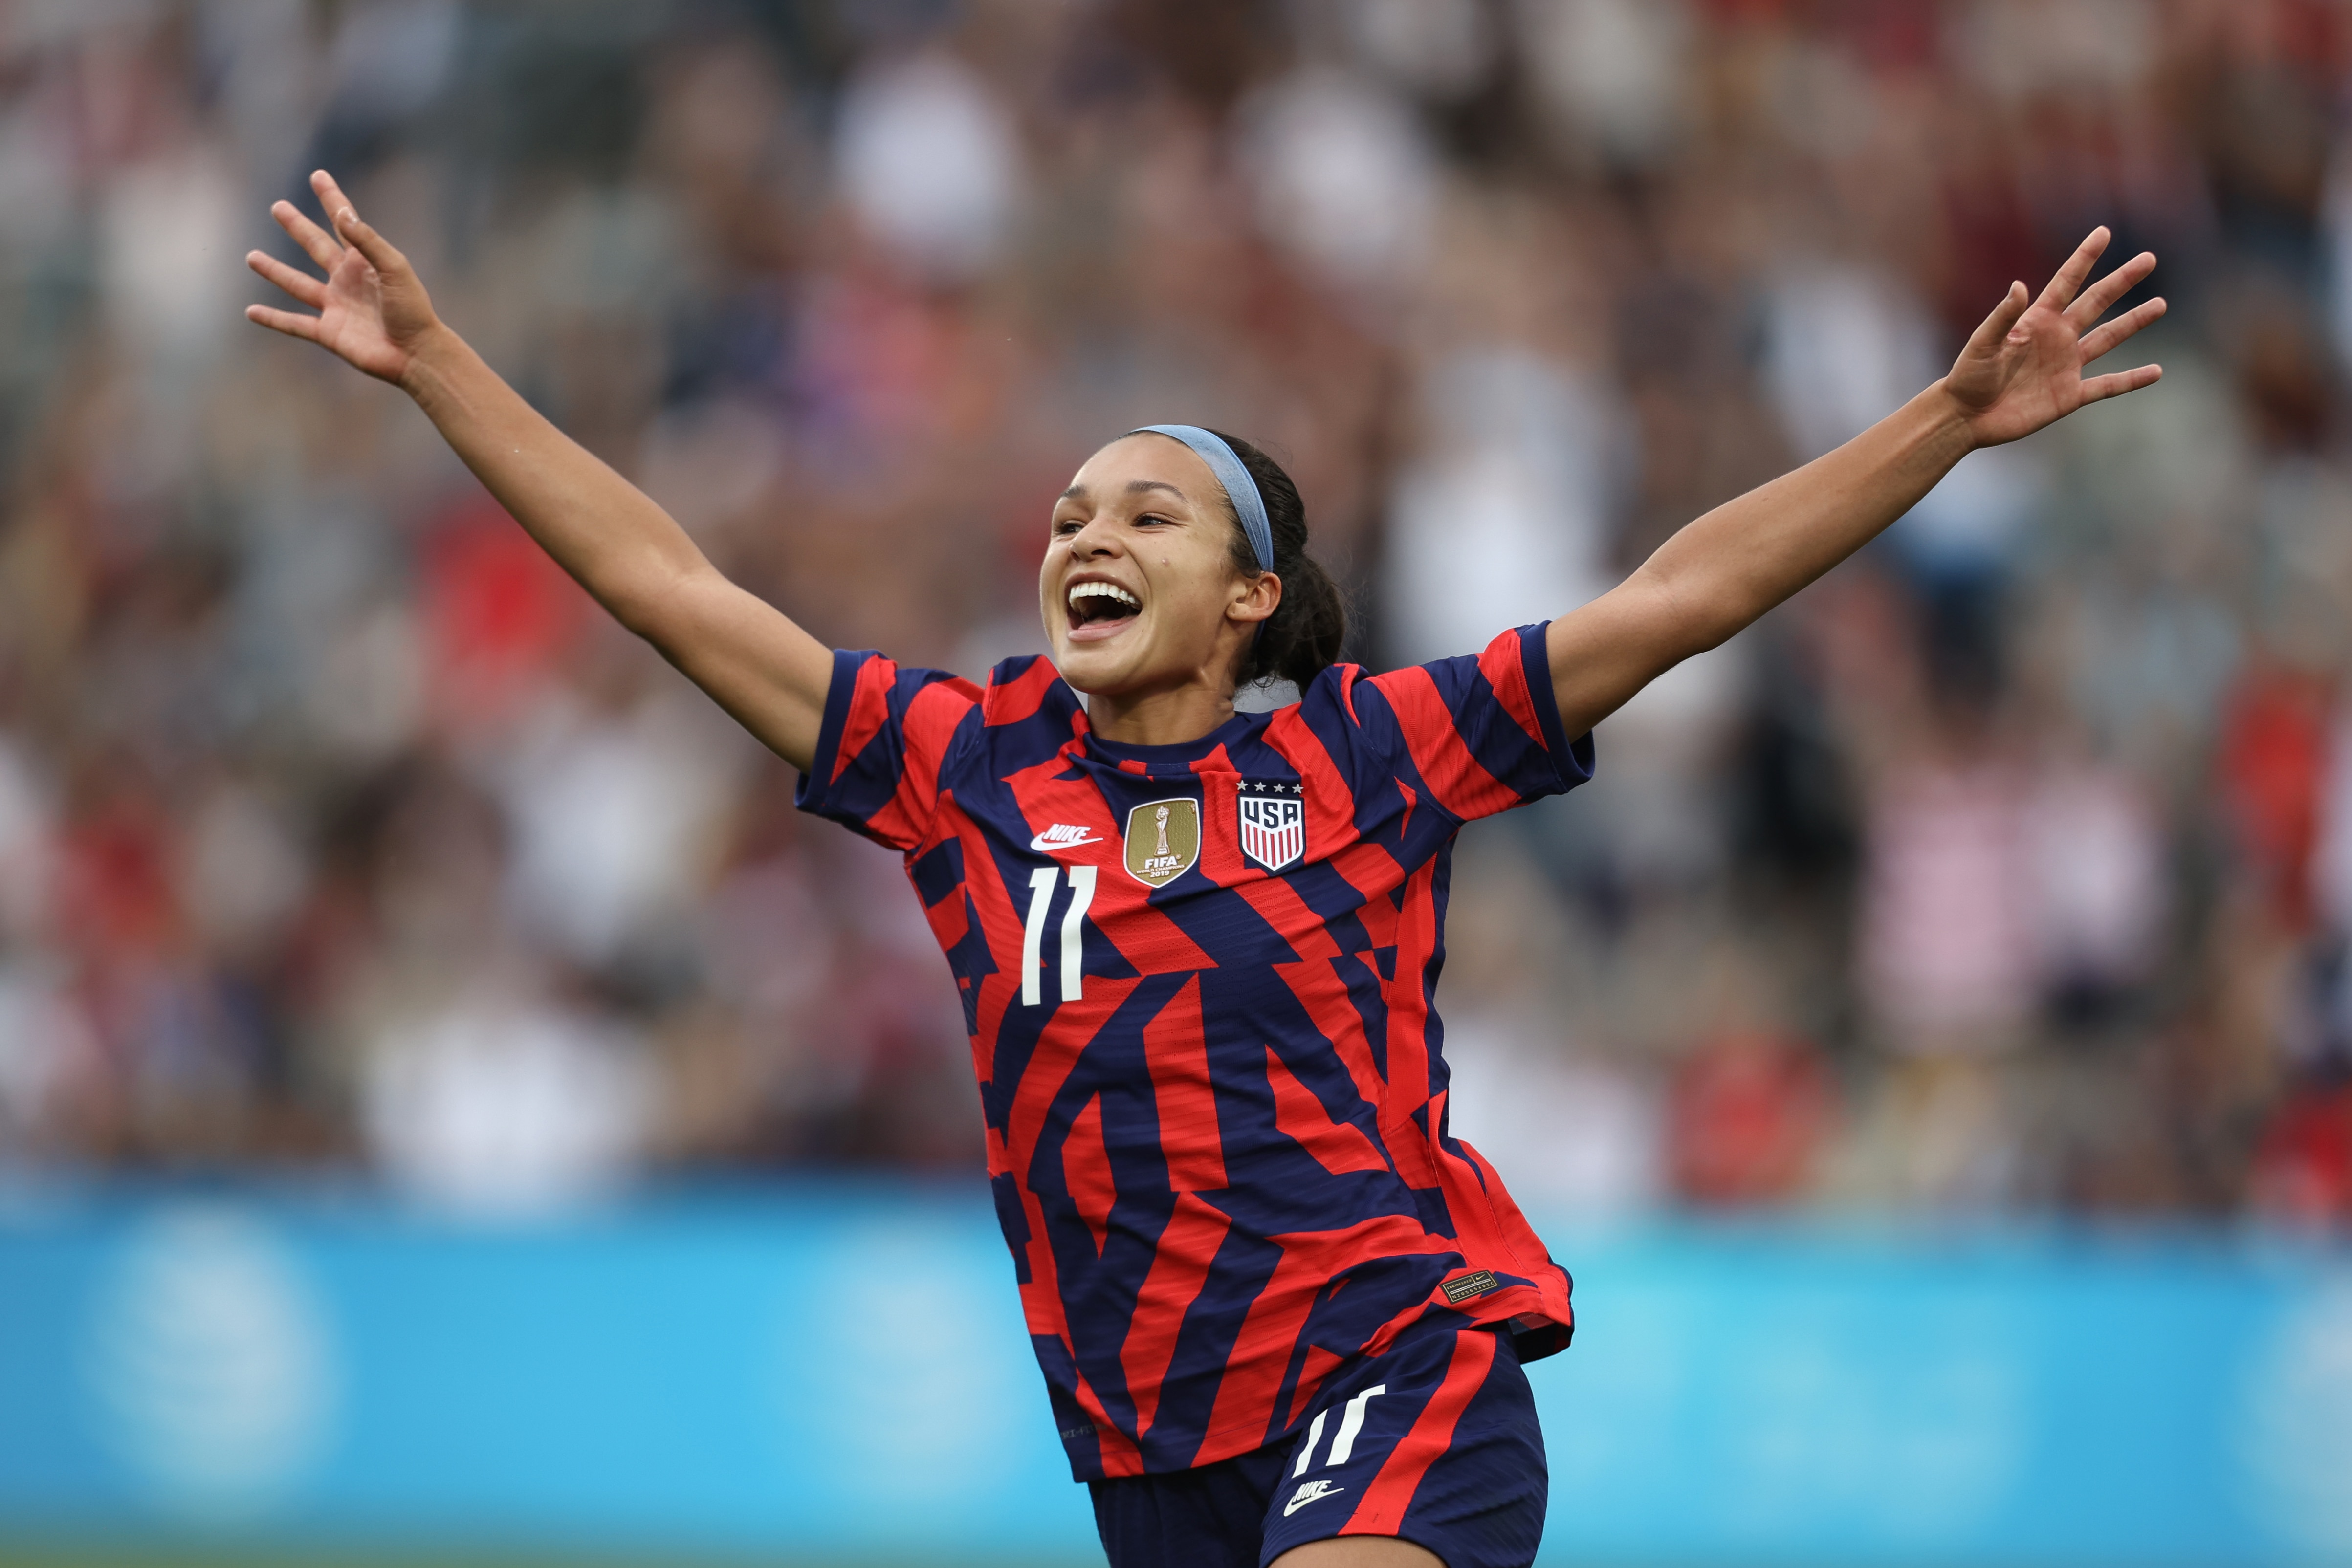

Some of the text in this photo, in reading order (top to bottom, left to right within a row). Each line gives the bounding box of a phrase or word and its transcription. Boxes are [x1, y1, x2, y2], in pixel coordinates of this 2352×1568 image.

[1244, 801, 1298, 829] USA
[1043, 823, 1091, 842] NIKE
[1145, 856, 1178, 869] FIFA
[1022, 866, 1098, 1006] 11
[1447, 1279, 1472, 1290] ENGINEERED
[1292, 1384, 1385, 1479] 11
[1292, 1480, 1332, 1503] NIKE
